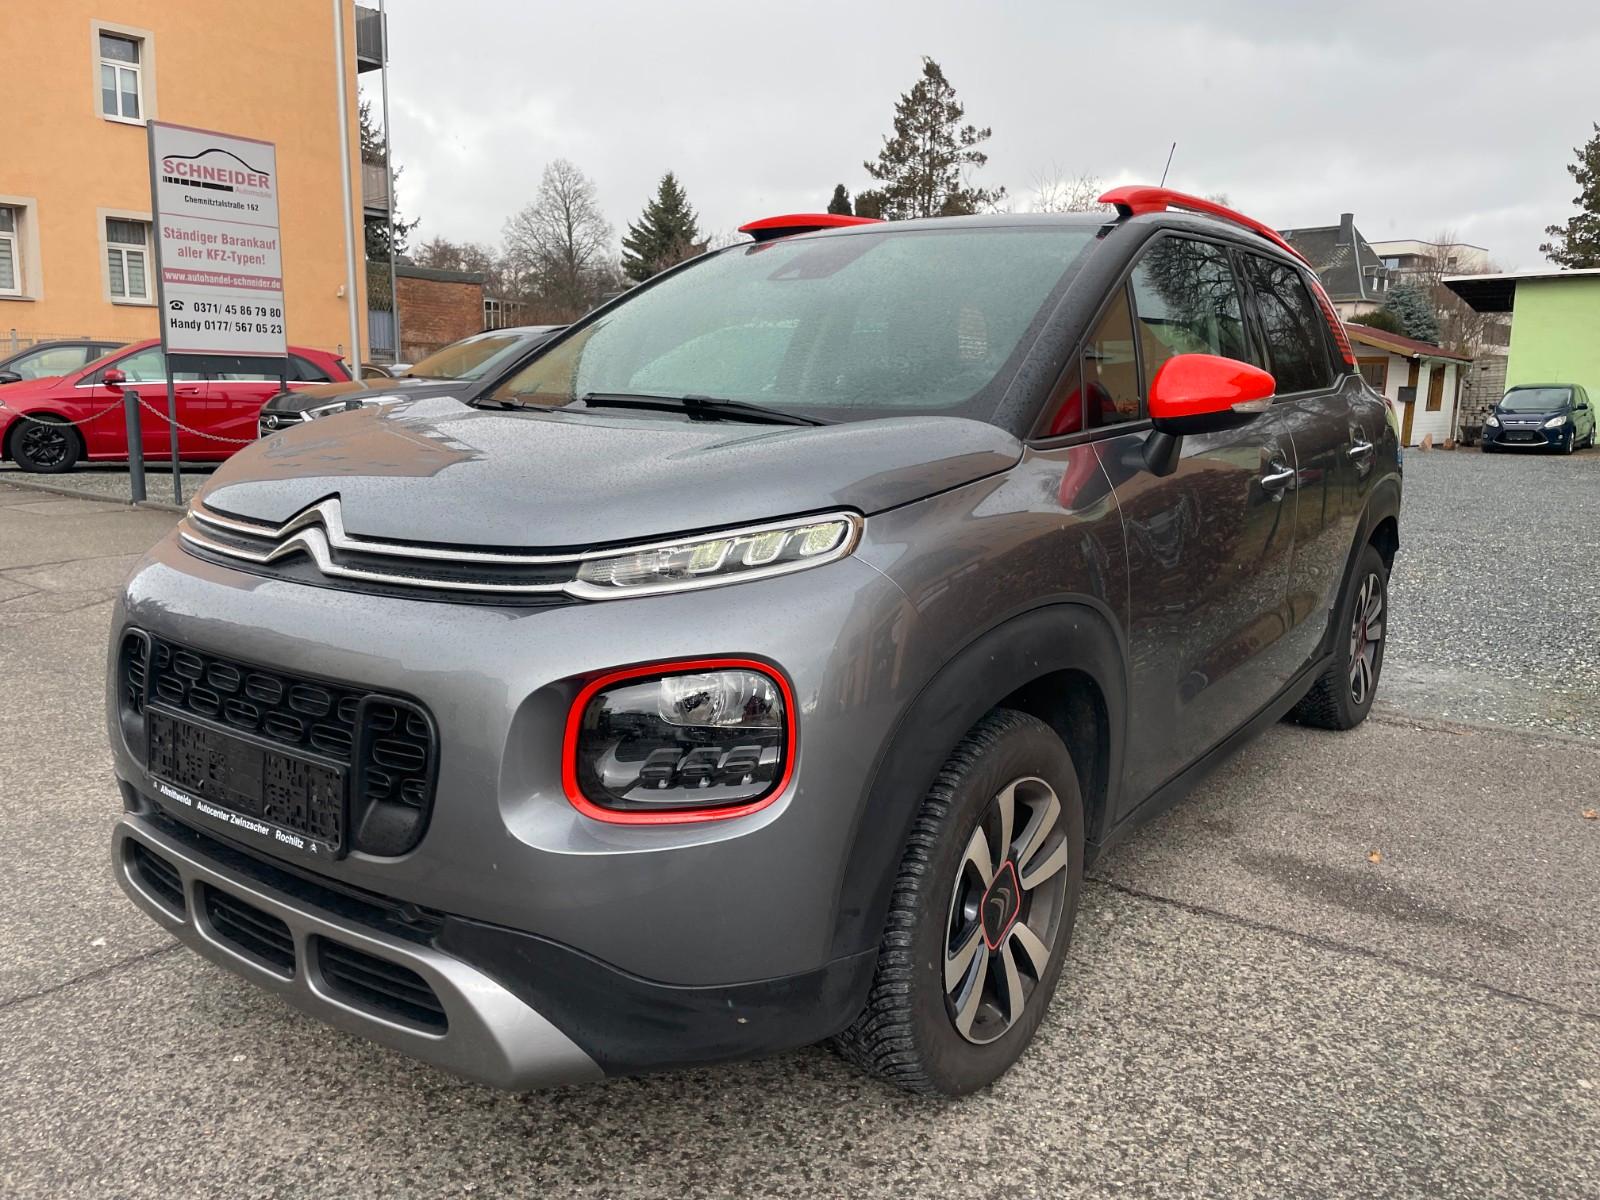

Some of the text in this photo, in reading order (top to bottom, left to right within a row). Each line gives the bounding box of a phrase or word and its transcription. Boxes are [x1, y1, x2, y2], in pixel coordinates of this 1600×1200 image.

[163, 160, 270, 189] SCHNEIDER
[184, 195, 259, 211] Chemnitztalstraße 162
[164, 226, 276, 250] Ständiger Barankauf
[178, 246, 266, 266] aller KFZ-Typen!
[164, 271, 281, 289] www.autohandel-schneider.de
[193, 302, 281, 318] 0371/ 45 86 79 80
[170, 318, 282, 335] Handy 0177/ 567 05 23
[196, 801, 230, 822] Autocenter
[230, 814, 270, 836] Zwinzscher
[275, 829, 304, 849] Rochlitz
